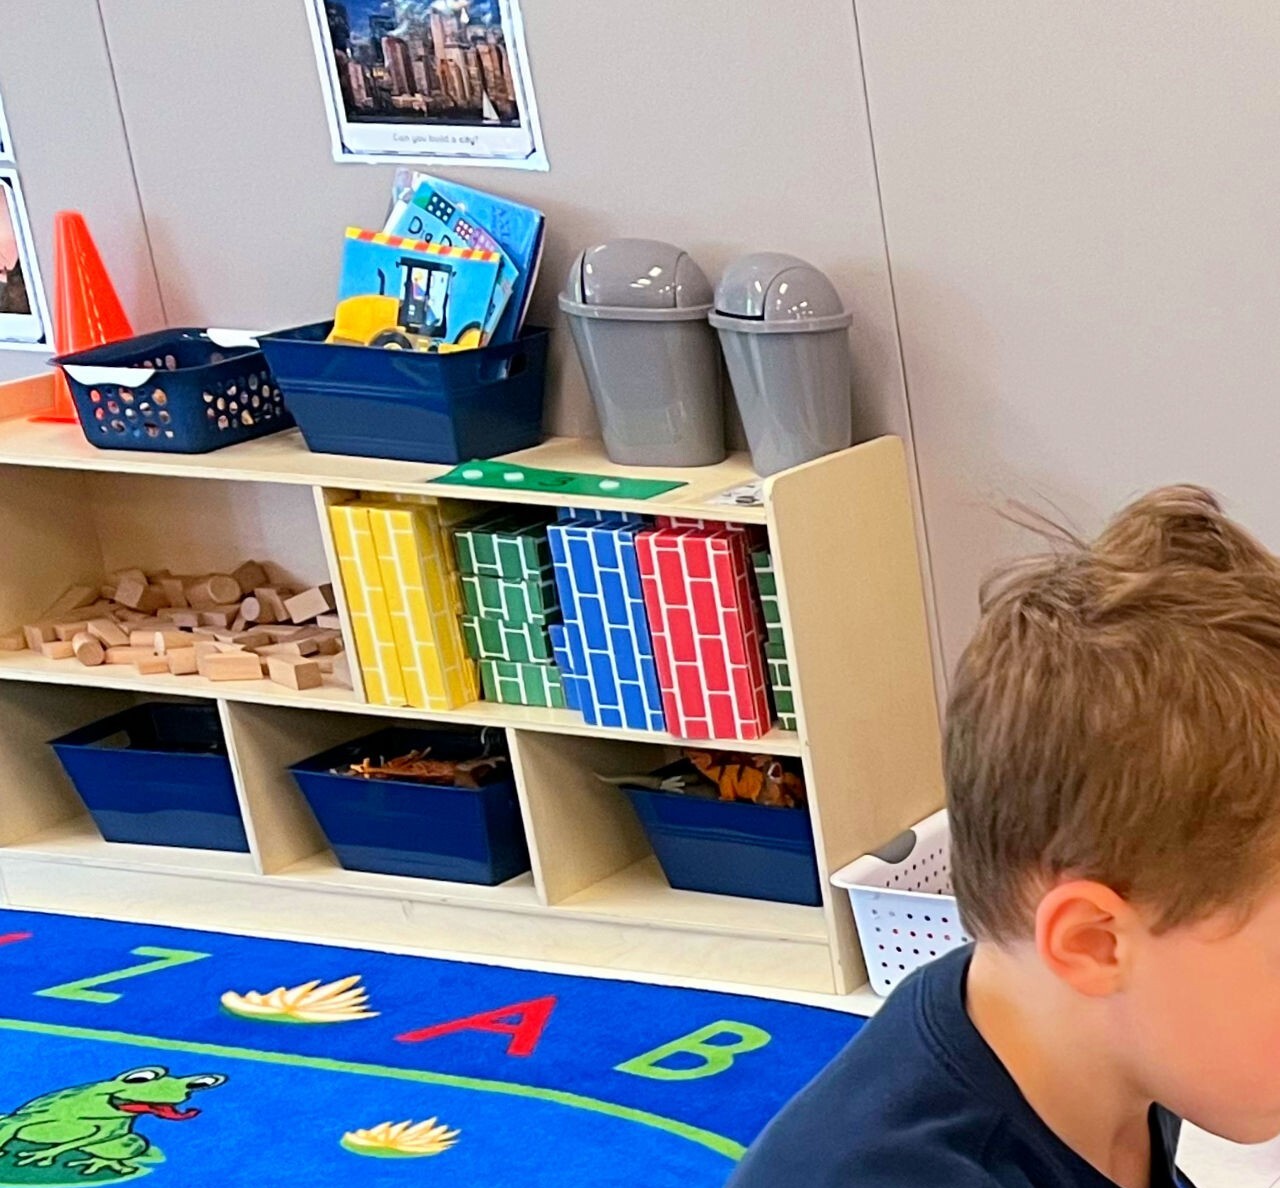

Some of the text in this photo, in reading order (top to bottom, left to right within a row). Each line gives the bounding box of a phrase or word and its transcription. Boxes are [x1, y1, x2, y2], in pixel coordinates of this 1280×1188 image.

[34, 945, 212, 1004] Z
[397, 996, 558, 1057] A
[613, 1018, 772, 1082] B
